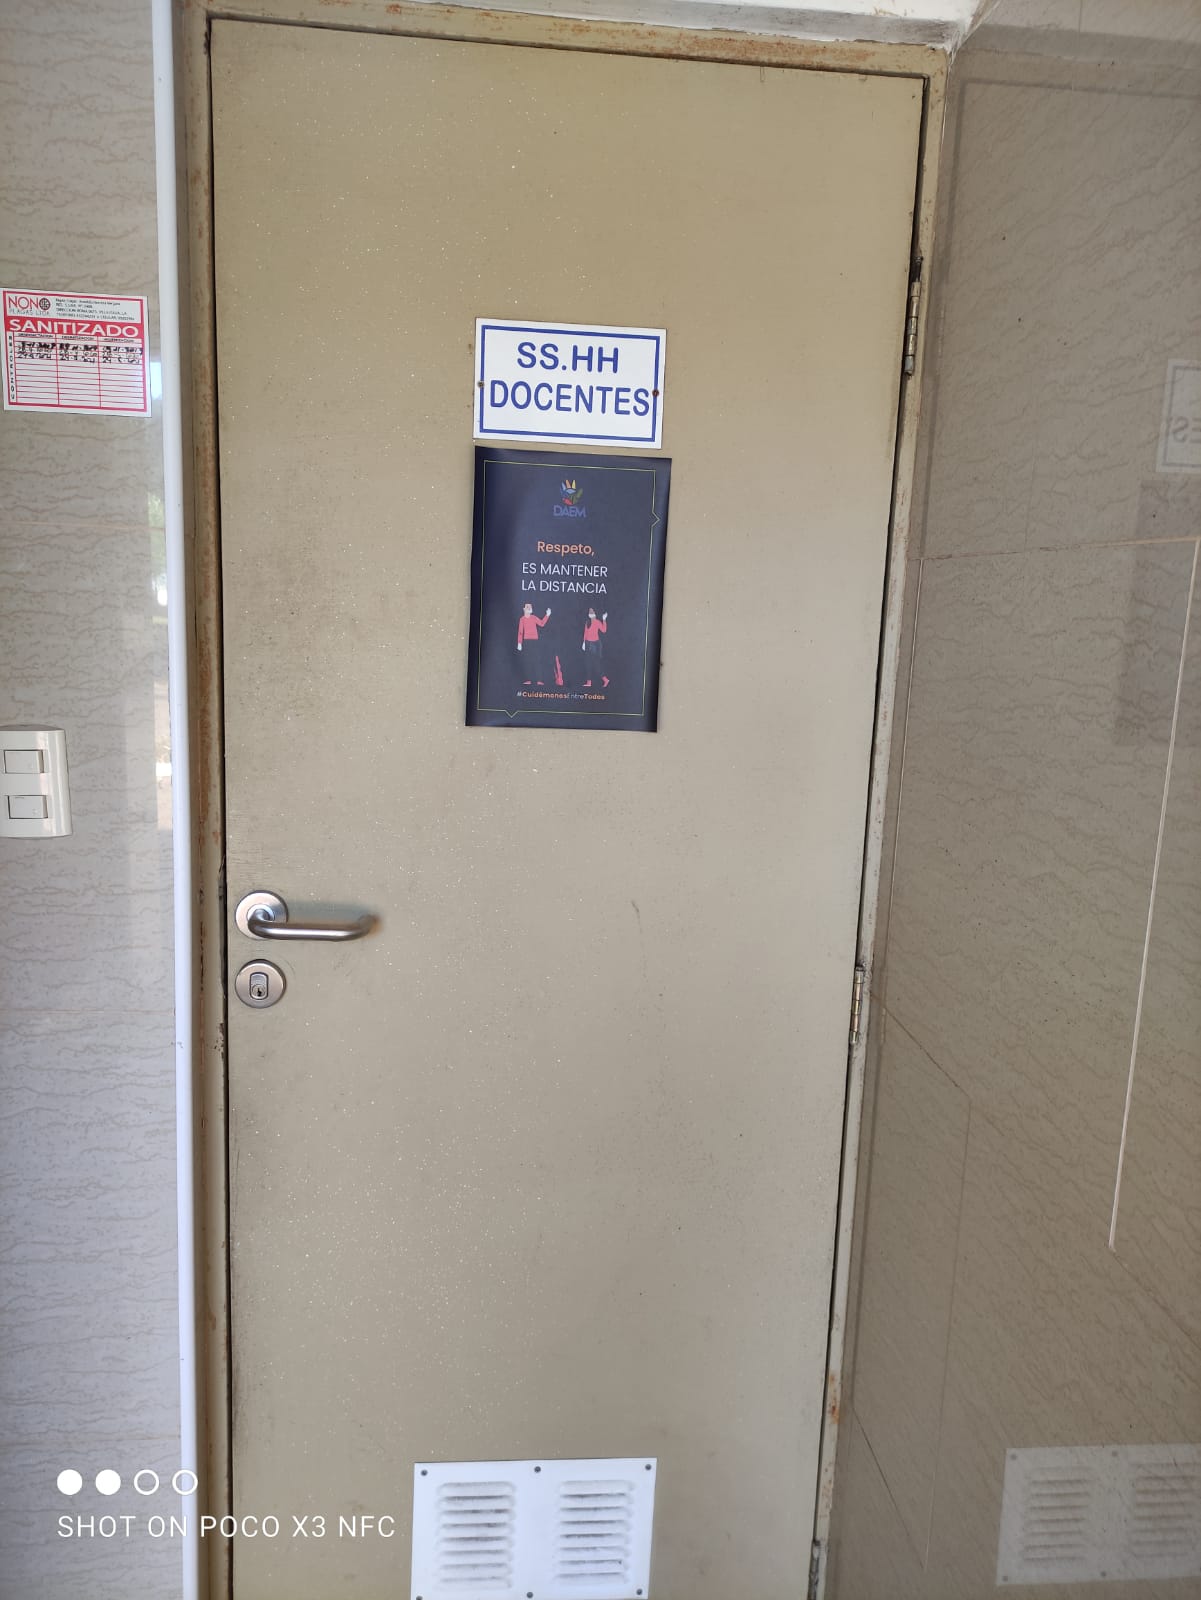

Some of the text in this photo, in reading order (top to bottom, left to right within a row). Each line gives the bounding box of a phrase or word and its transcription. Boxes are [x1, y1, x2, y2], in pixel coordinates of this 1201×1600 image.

[9, 319, 139, 338] SANITIZADO
[517, 341, 619, 373] SS.HH
[490, 379, 650, 416] DOCENTES
[553, 504, 586, 518] DAEM
[537, 541, 595, 557] Respeto,
[522, 562, 608, 578] ES MANTENER
[521, 579, 607, 594] LA DISTANCIA
